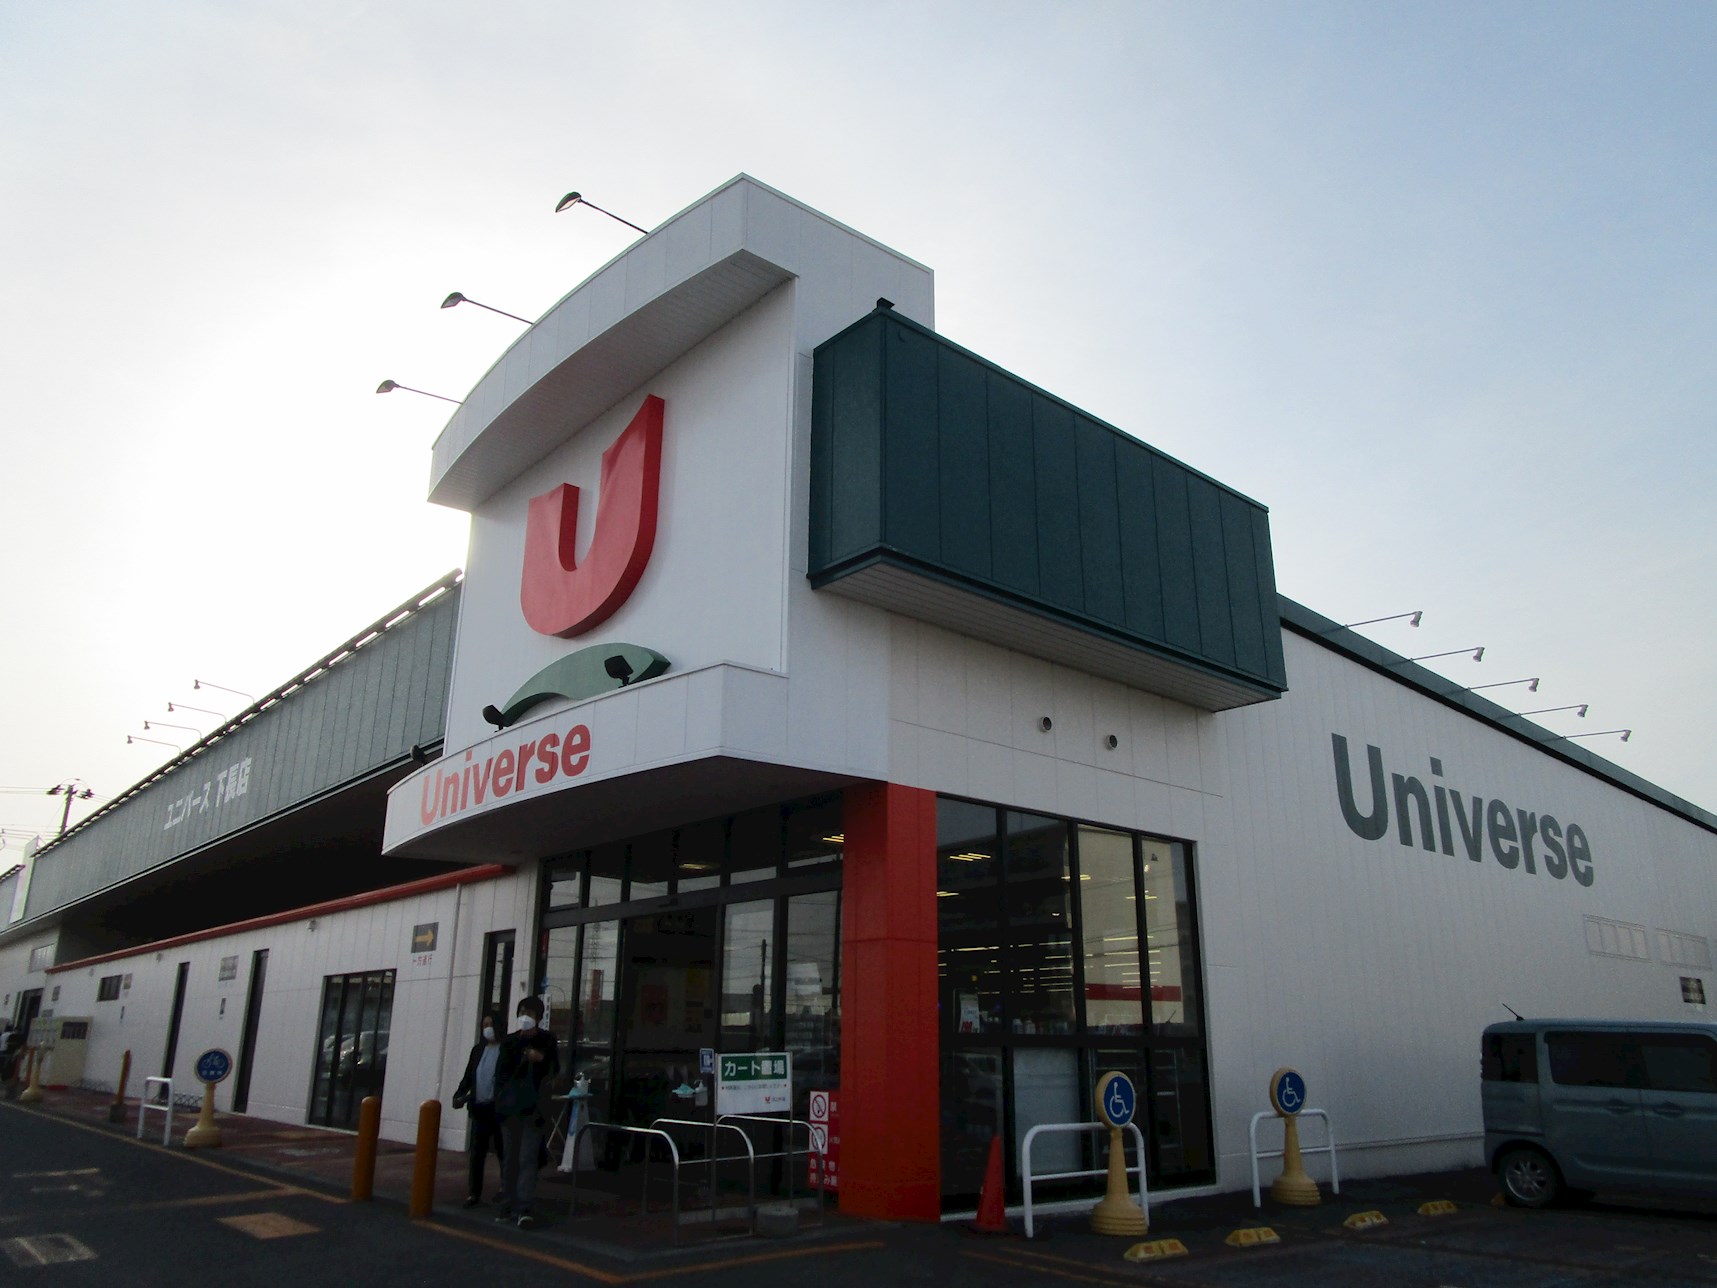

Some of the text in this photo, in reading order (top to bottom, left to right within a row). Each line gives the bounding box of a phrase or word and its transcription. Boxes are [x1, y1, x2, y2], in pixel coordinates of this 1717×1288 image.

[163, 756, 252, 831] ユニバース 下長店
[420, 724, 591, 826] Universe
[1331, 733, 1594, 887] Universe
[724, 1060, 785, 1077] カート置場
